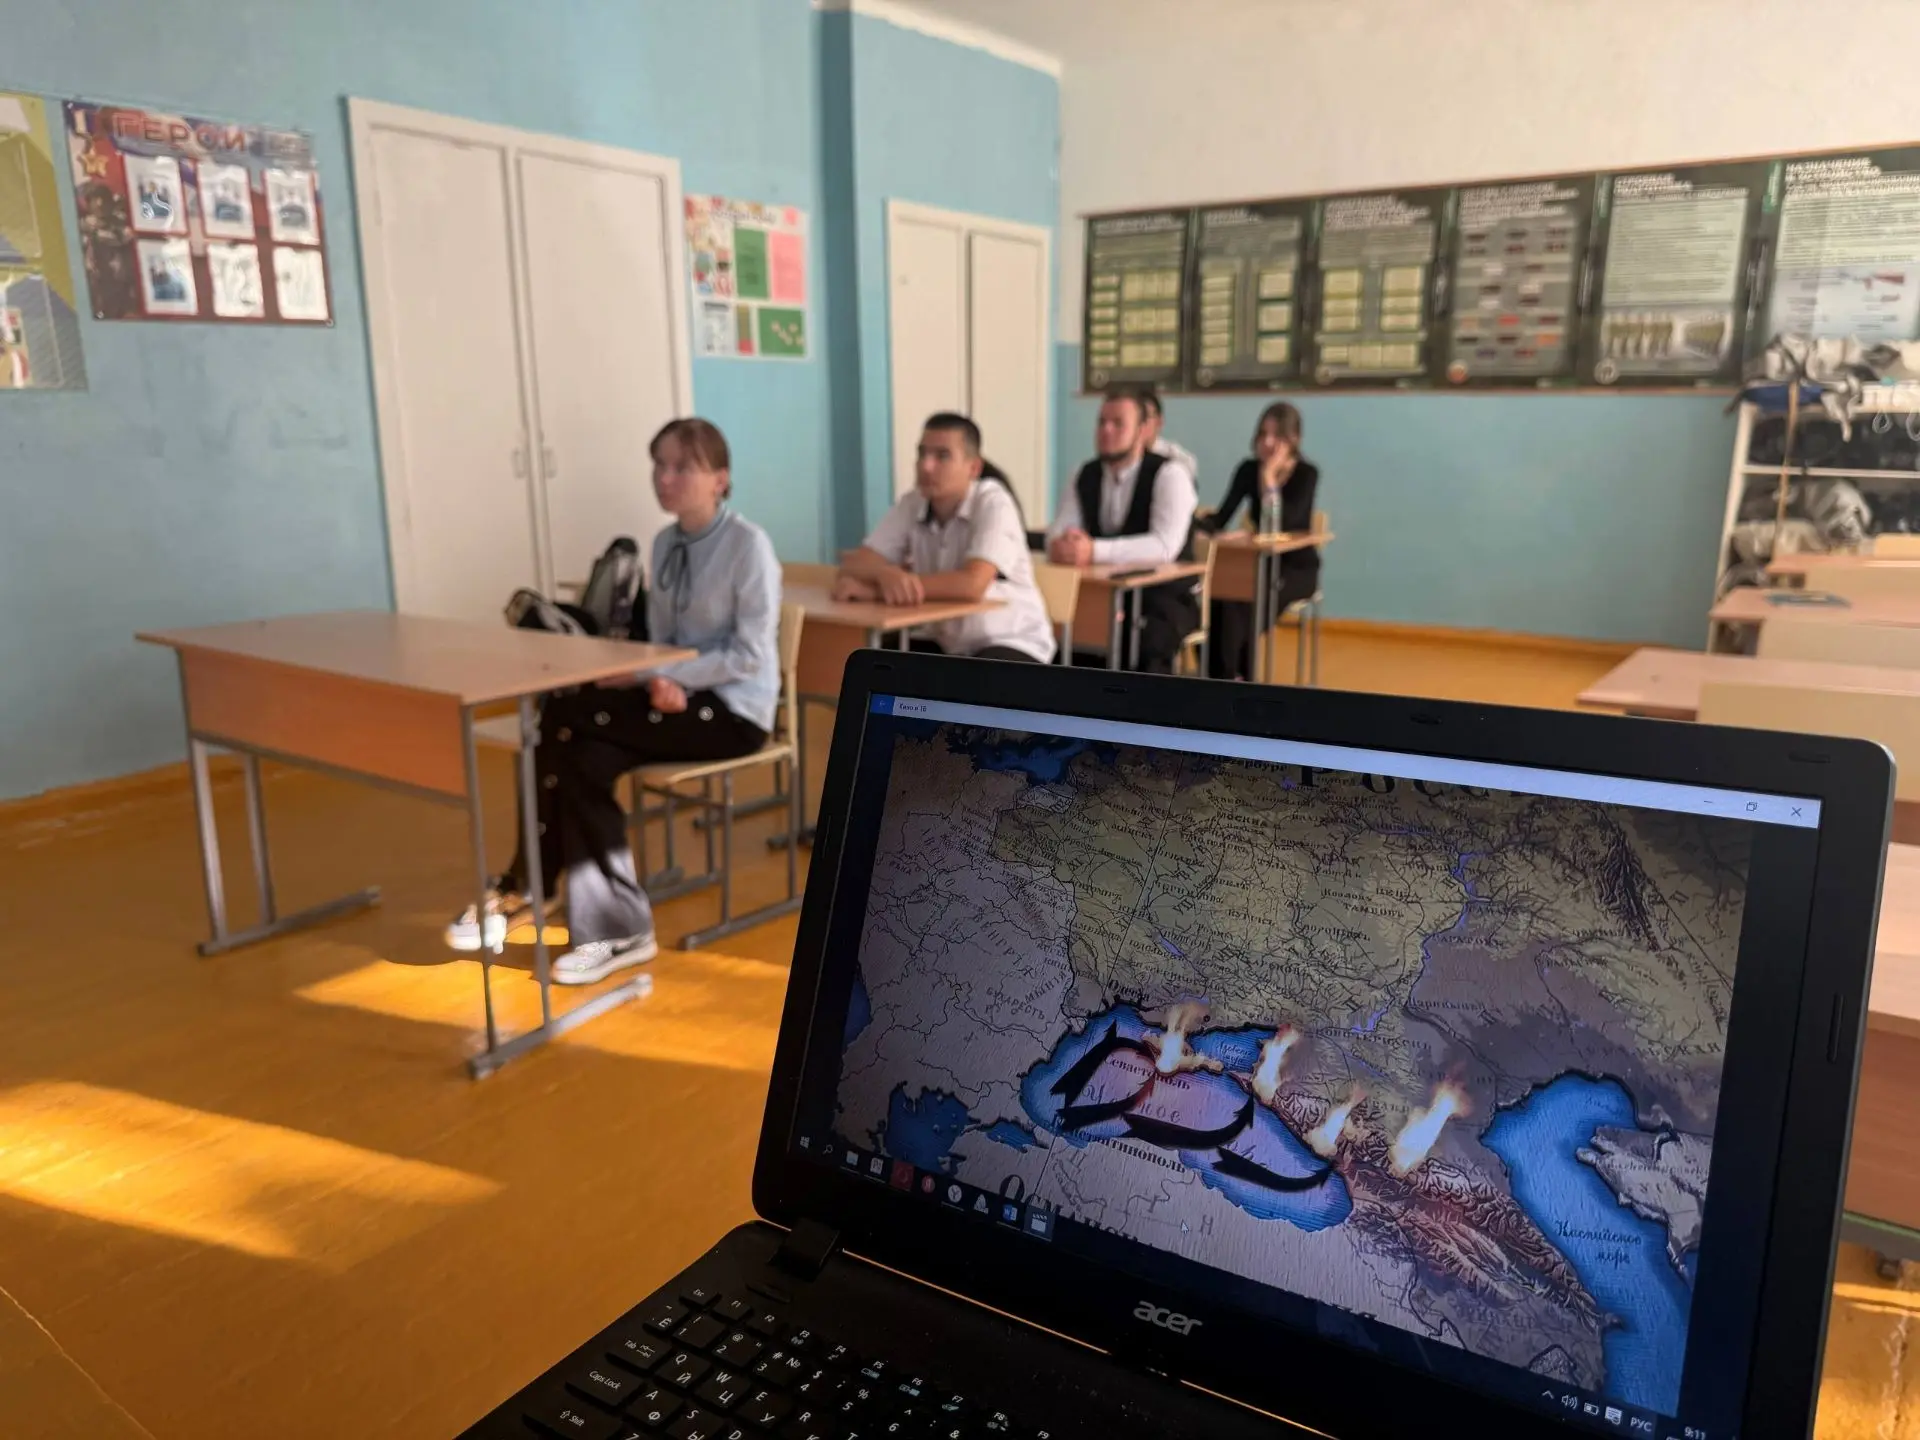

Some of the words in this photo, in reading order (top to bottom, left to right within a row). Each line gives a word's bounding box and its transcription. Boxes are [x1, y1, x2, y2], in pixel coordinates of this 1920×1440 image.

[730, 1299, 742, 1309] F1
[763, 1314, 776, 1323] F2
[1132, 1299, 1204, 1337] acer
[732, 1332, 744, 1343] @
[799, 1329, 811, 1339] F3
[624, 1339, 637, 1351] Tab
[715, 1344, 727, 1354] 2
[835, 1345, 847, 1354] F4
[674, 1353, 687, 1366] Q
[873, 1360, 885, 1370] F5
[756, 1362, 768, 1373] 3
[588, 1369, 606, 1384] Caps
[603, 1377, 622, 1390] Lock
[715, 1371, 732, 1384] W
[911, 1377, 924, 1386] F6
[800, 1383, 810, 1393] 4
[644, 1389, 659, 1401] A
[717, 1389, 735, 1405] Ц
[755, 1391, 769, 1402] E
[951, 1395, 964, 1404] F7
[841, 1401, 855, 1412] 5
[647, 1410, 661, 1421] Ф
[686, 1409, 698, 1420] S
[798, 1411, 812, 1423] R
[993, 1411, 1007, 1422] F8
[569, 1414, 585, 1428] Shift
[1630, 1416, 1652, 1432] РУС
[888, 1422, 901, 1433] 6
[728, 1429, 743, 1440] D
[1037, 1430, 1051, 1440] F9
